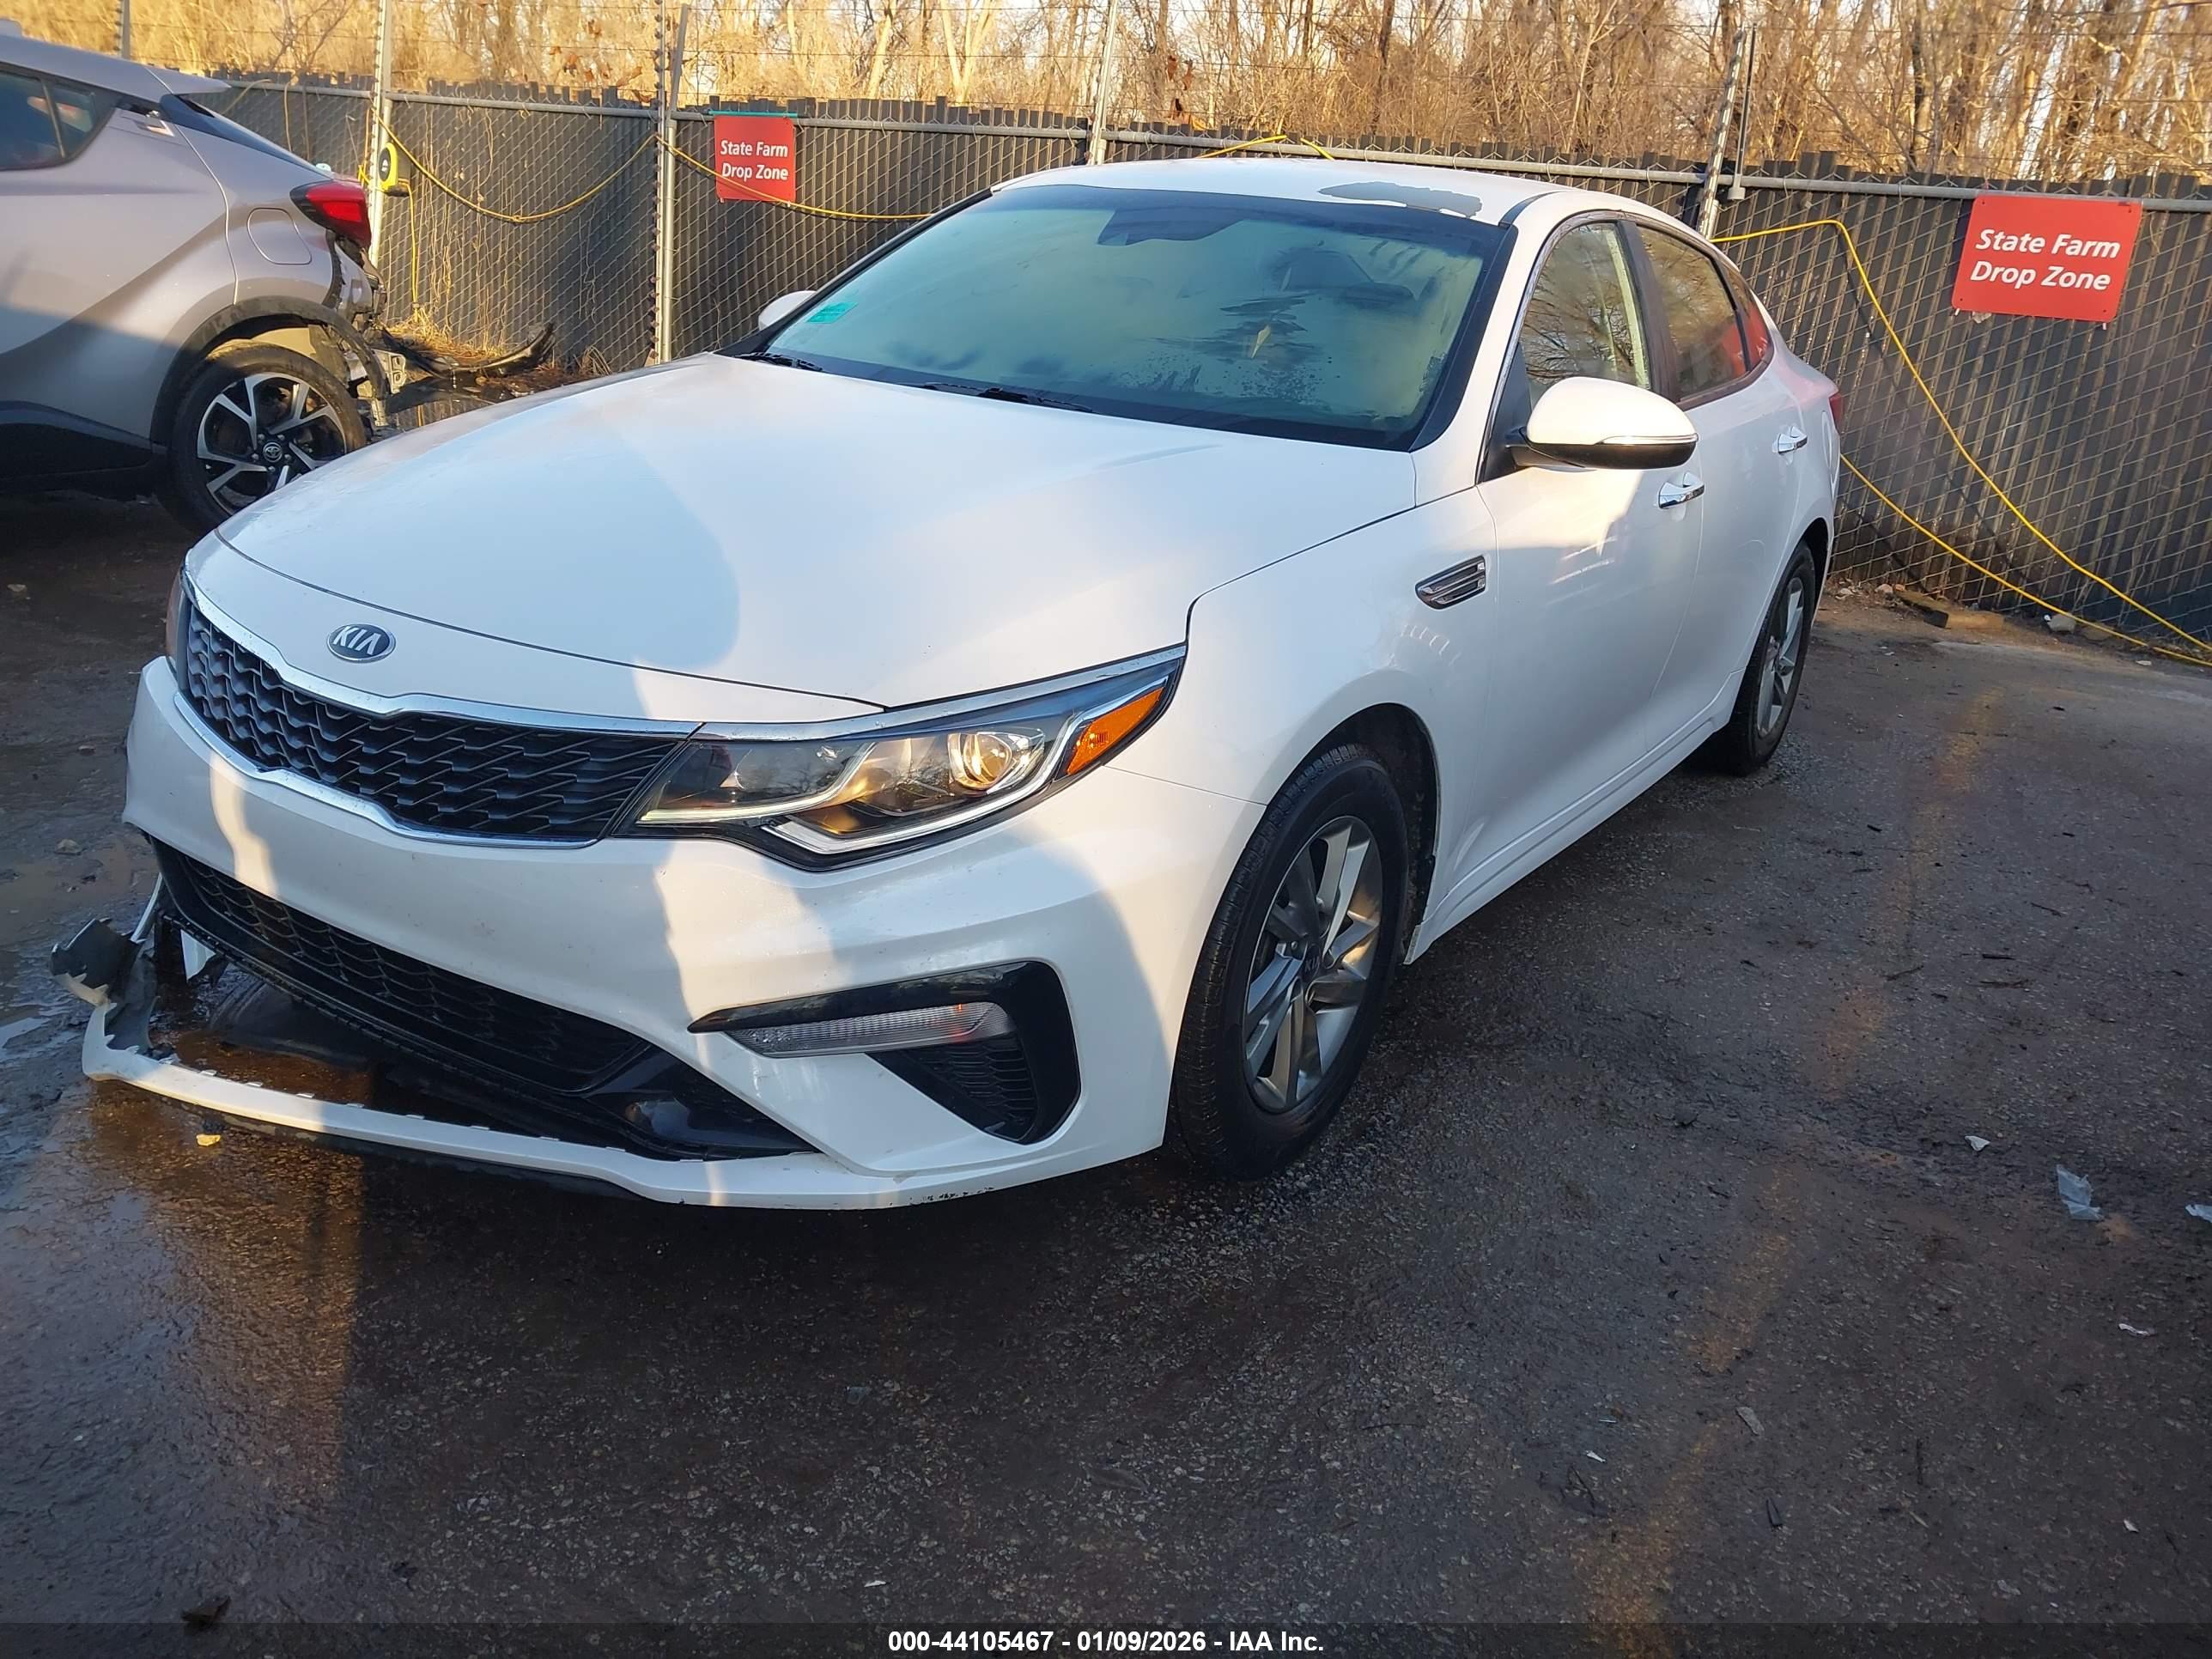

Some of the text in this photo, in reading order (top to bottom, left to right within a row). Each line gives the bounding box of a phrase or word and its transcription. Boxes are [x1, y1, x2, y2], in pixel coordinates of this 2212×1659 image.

[720, 140, 789, 158] State Farm
[721, 162, 789, 182] Drop Zone
[1975, 228, 2121, 258] State Farm
[1970, 261, 2111, 291] Drop Zone
[331, 626, 382, 656] KIA
